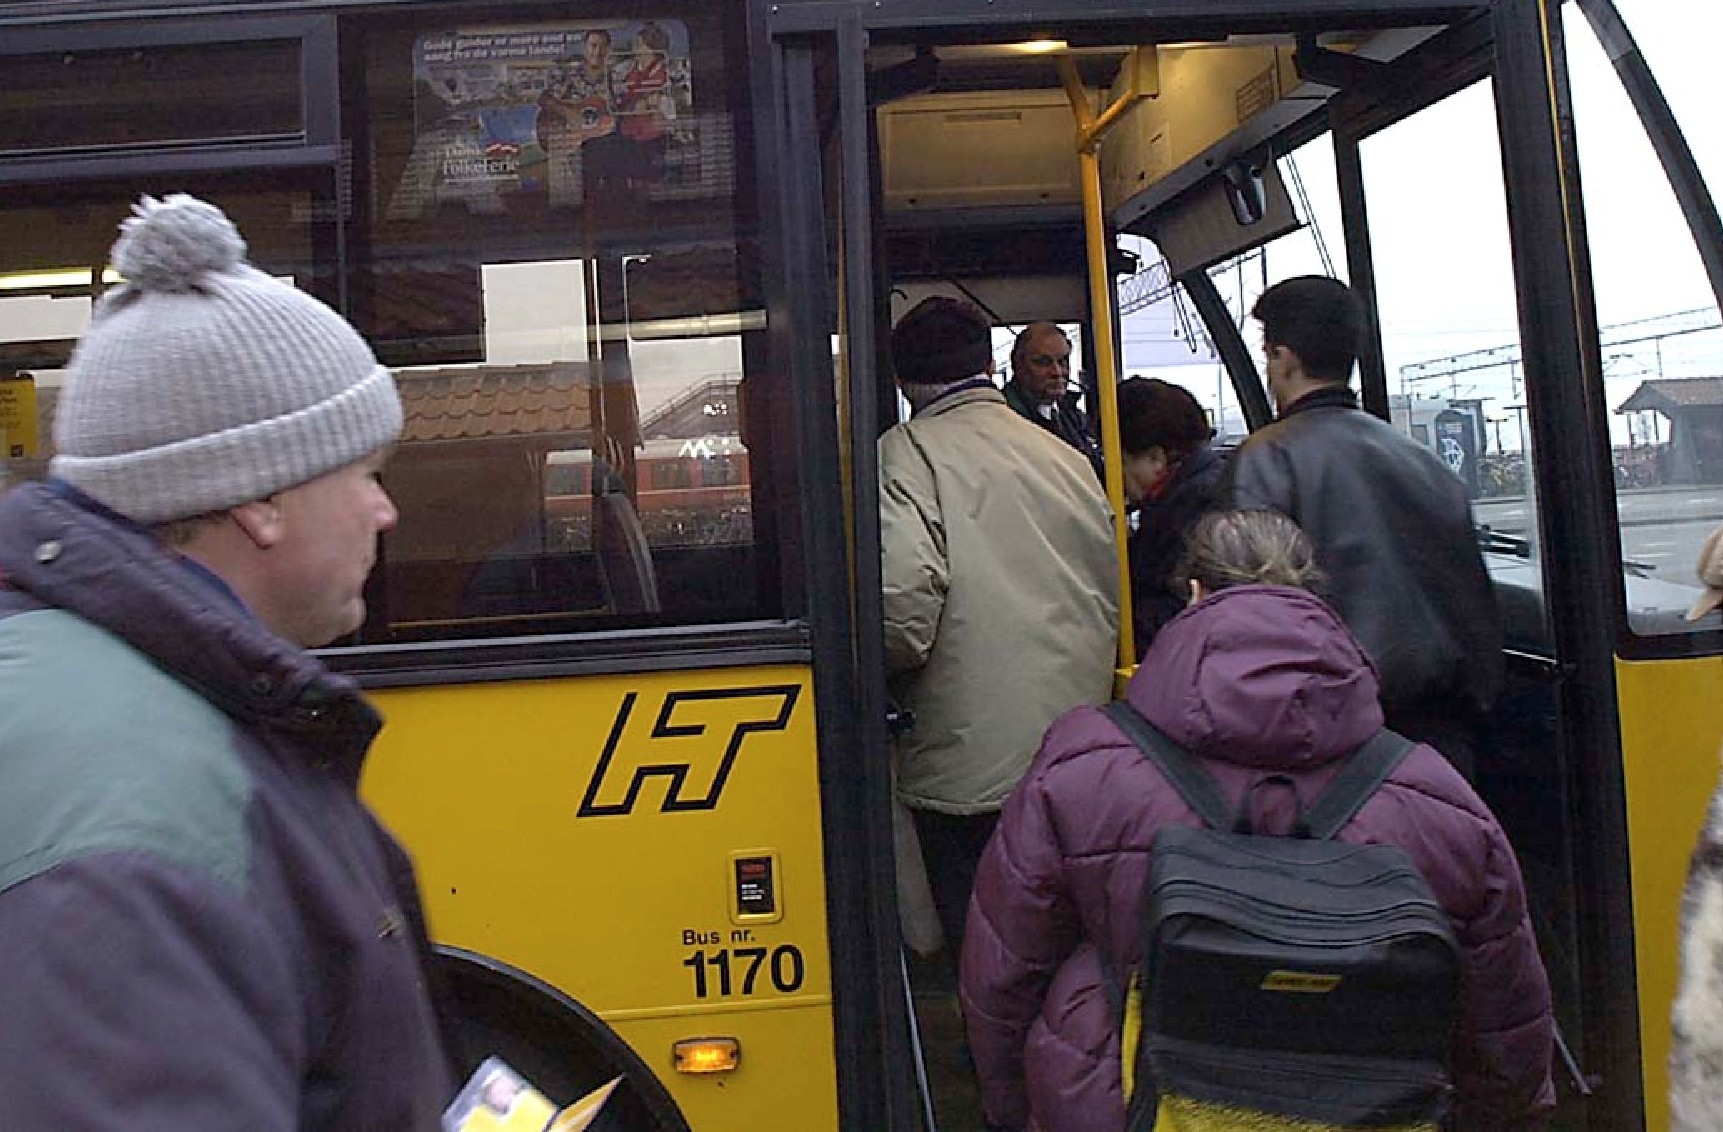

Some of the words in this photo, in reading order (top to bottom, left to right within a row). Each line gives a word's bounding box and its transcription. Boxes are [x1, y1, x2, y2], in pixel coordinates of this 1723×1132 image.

[576, 683, 803, 818] HT
[682, 928, 721, 946] Bus
[730, 927, 757, 944] nr.
[682, 943, 805, 998] 1170
